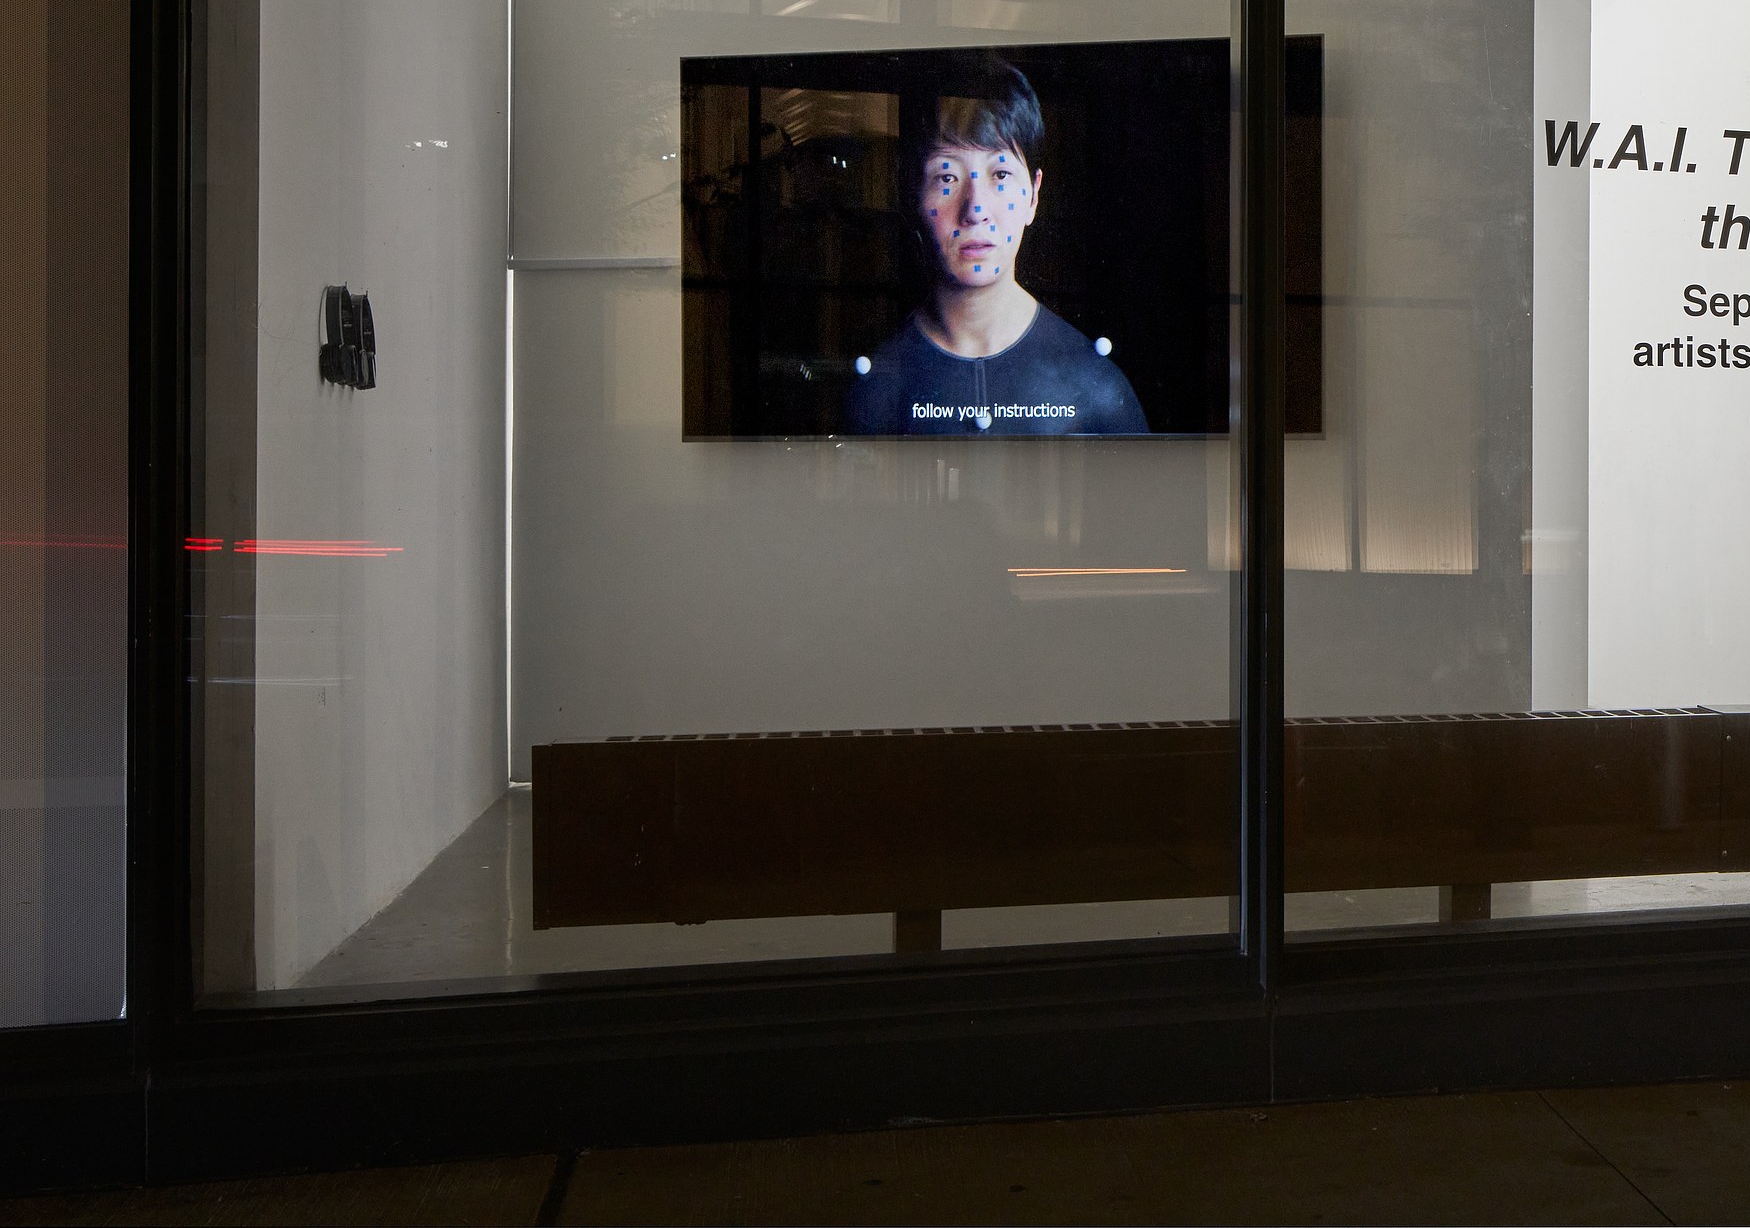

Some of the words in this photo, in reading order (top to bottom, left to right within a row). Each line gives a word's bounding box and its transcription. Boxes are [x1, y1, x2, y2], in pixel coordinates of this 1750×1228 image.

[1545, 120, 1696, 172] W.A.I.
[912, 403, 953, 418] follow
[958, 406, 990, 421] your
[994, 403, 1075, 417] instructions
